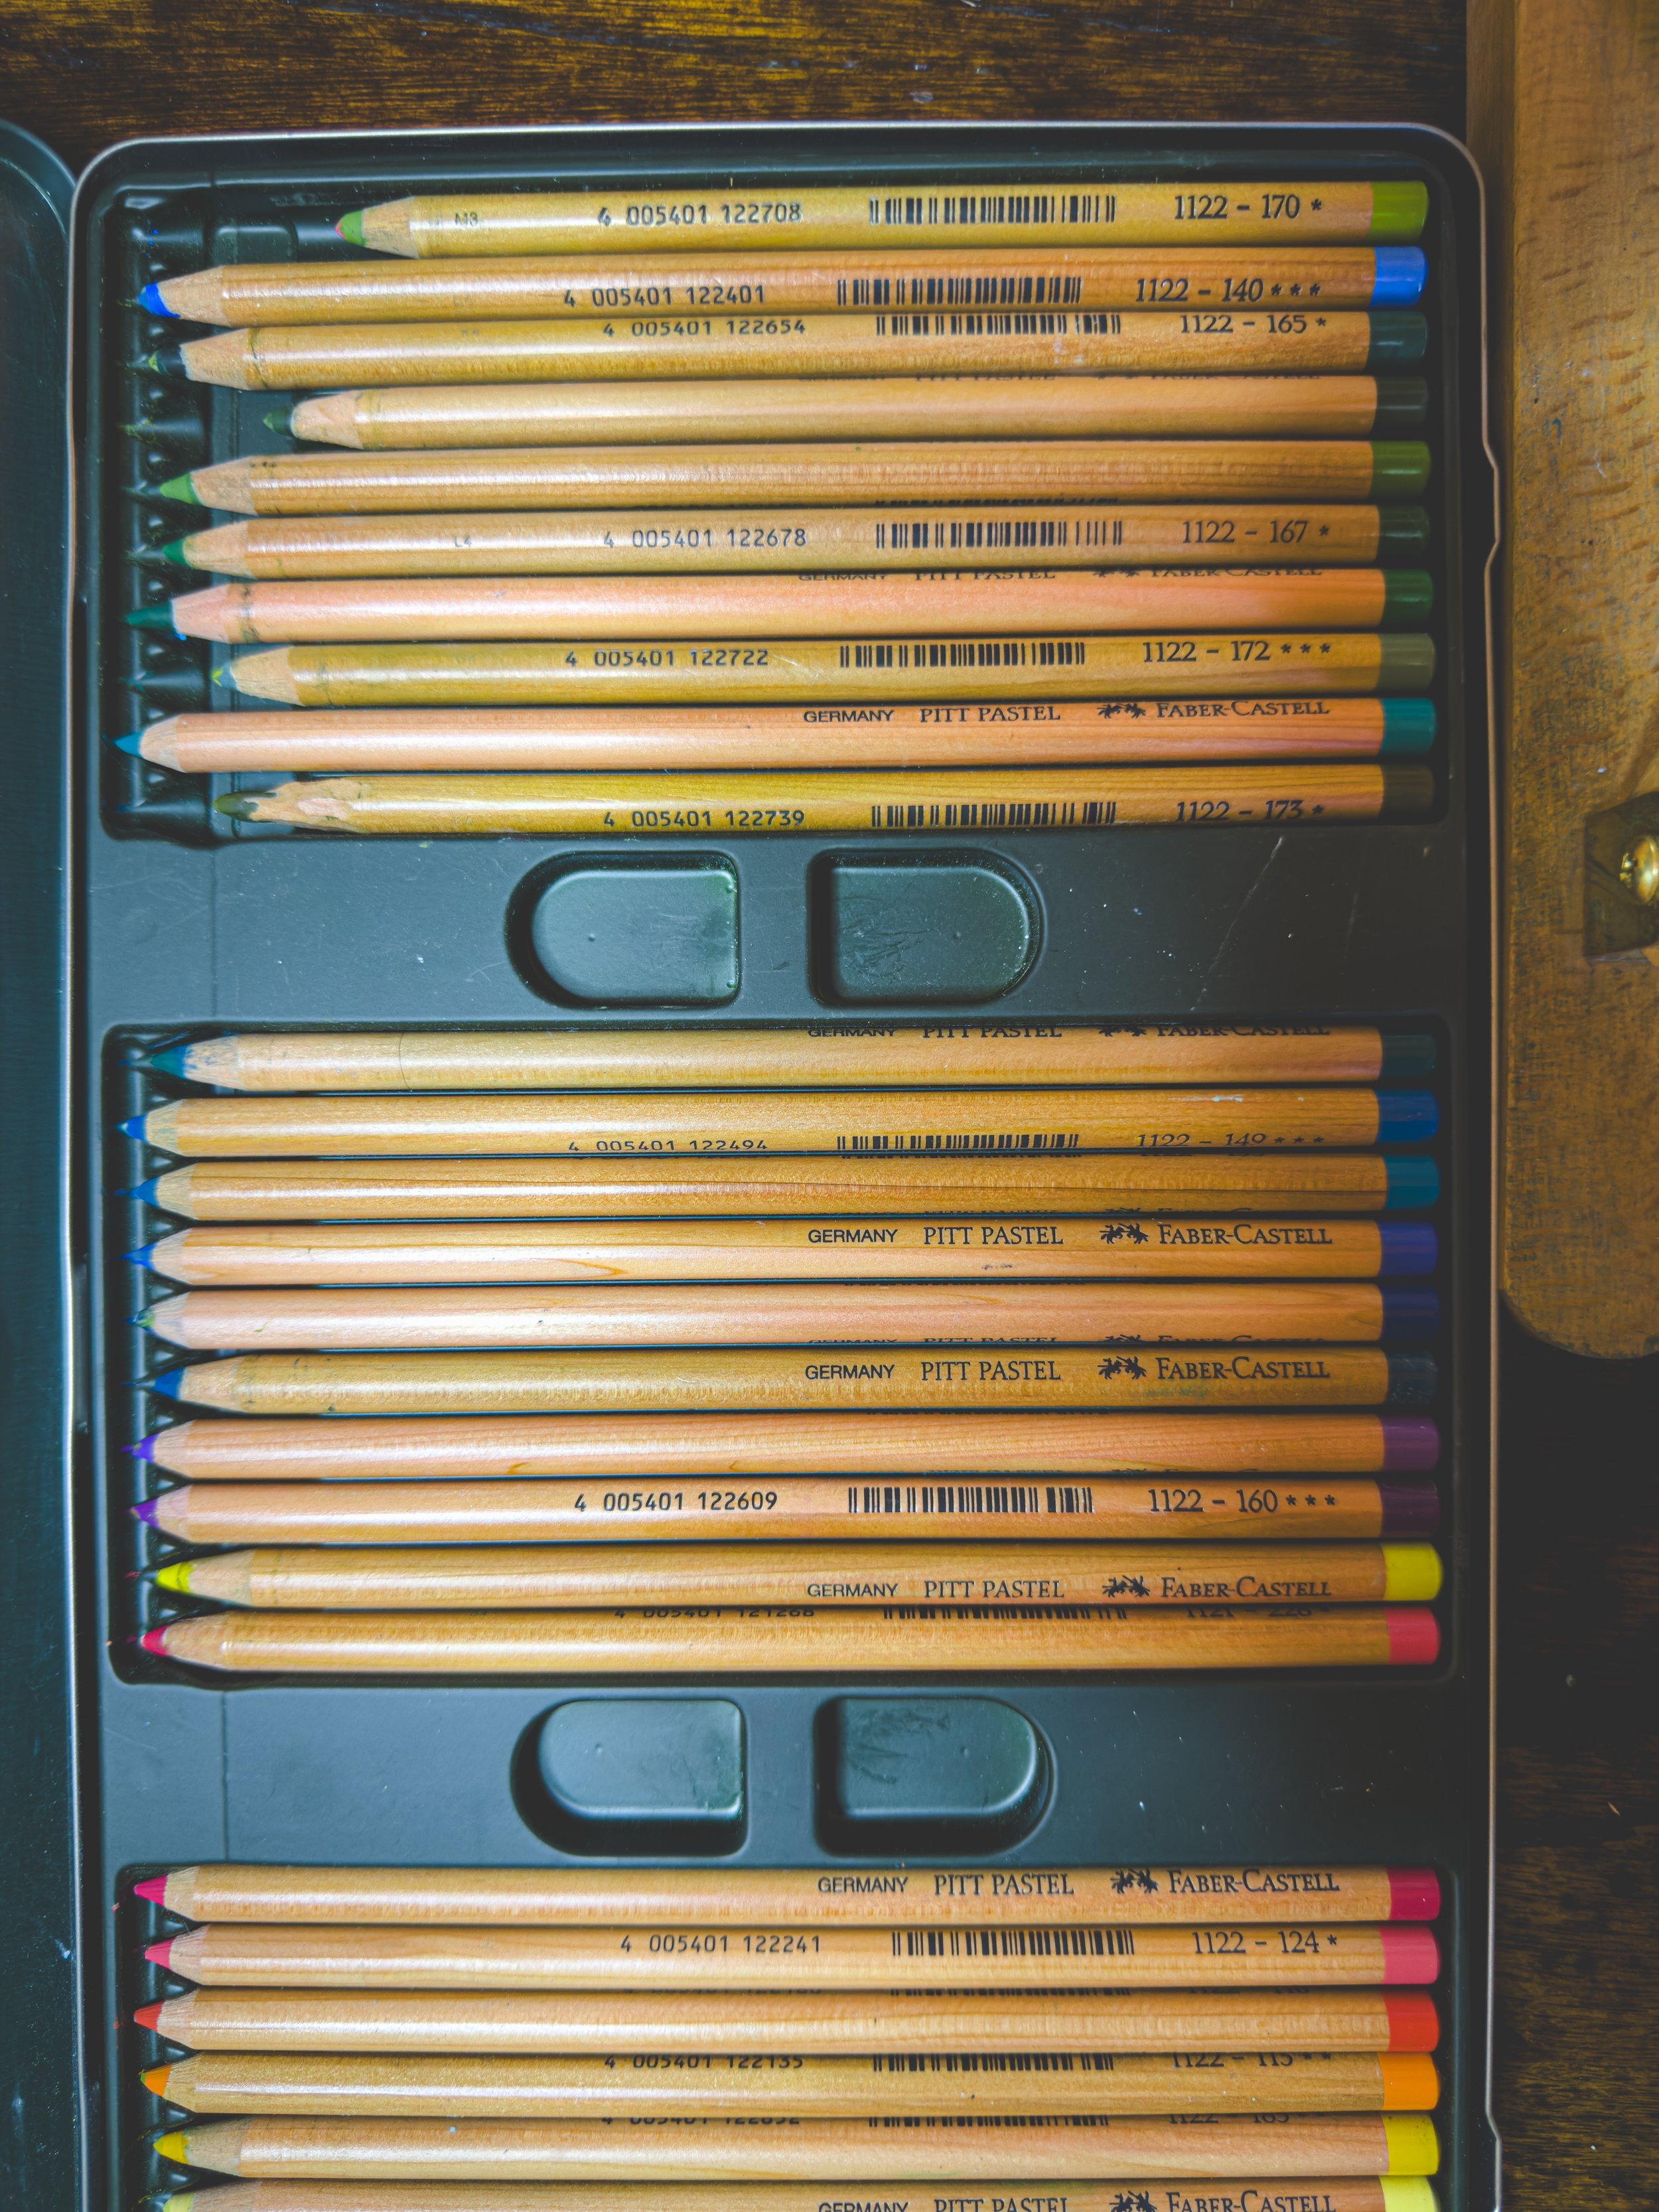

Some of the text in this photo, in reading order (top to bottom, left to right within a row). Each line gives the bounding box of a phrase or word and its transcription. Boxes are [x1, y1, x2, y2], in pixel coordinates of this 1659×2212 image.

[598, 202, 802, 227] 4 005401 122708
[564, 285, 764, 307] 4 005401 122401
[603, 319, 806, 337] 4 005401 122654
[603, 528, 806, 548] 4 005401 122678
[565, 648, 769, 667] 4 005401 122722
[804, 700, 1330, 723] GERMANY PITT PASTEL FABER-CASTELL
[603, 810, 805, 827] 4 005401 122739
[568, 1140, 768, 1151] 4 005401 122494
[808, 1223, 1333, 1245] GERMANY PITT PASTEL FABER-CASTELL
[804, 1355, 1331, 1380] GERMANY PITT PASTEL FABER-CASTELL
[575, 1491, 778, 1512] 4 005401 122609
[807, 1575, 1332, 1599] GERMANY PITT PASTEL FABER-CASTELL
[818, 1868, 1340, 1896] GERMANY PITT PASTEL FABER-CASTELL
[620, 1935, 820, 1953] 4 005401 122241
